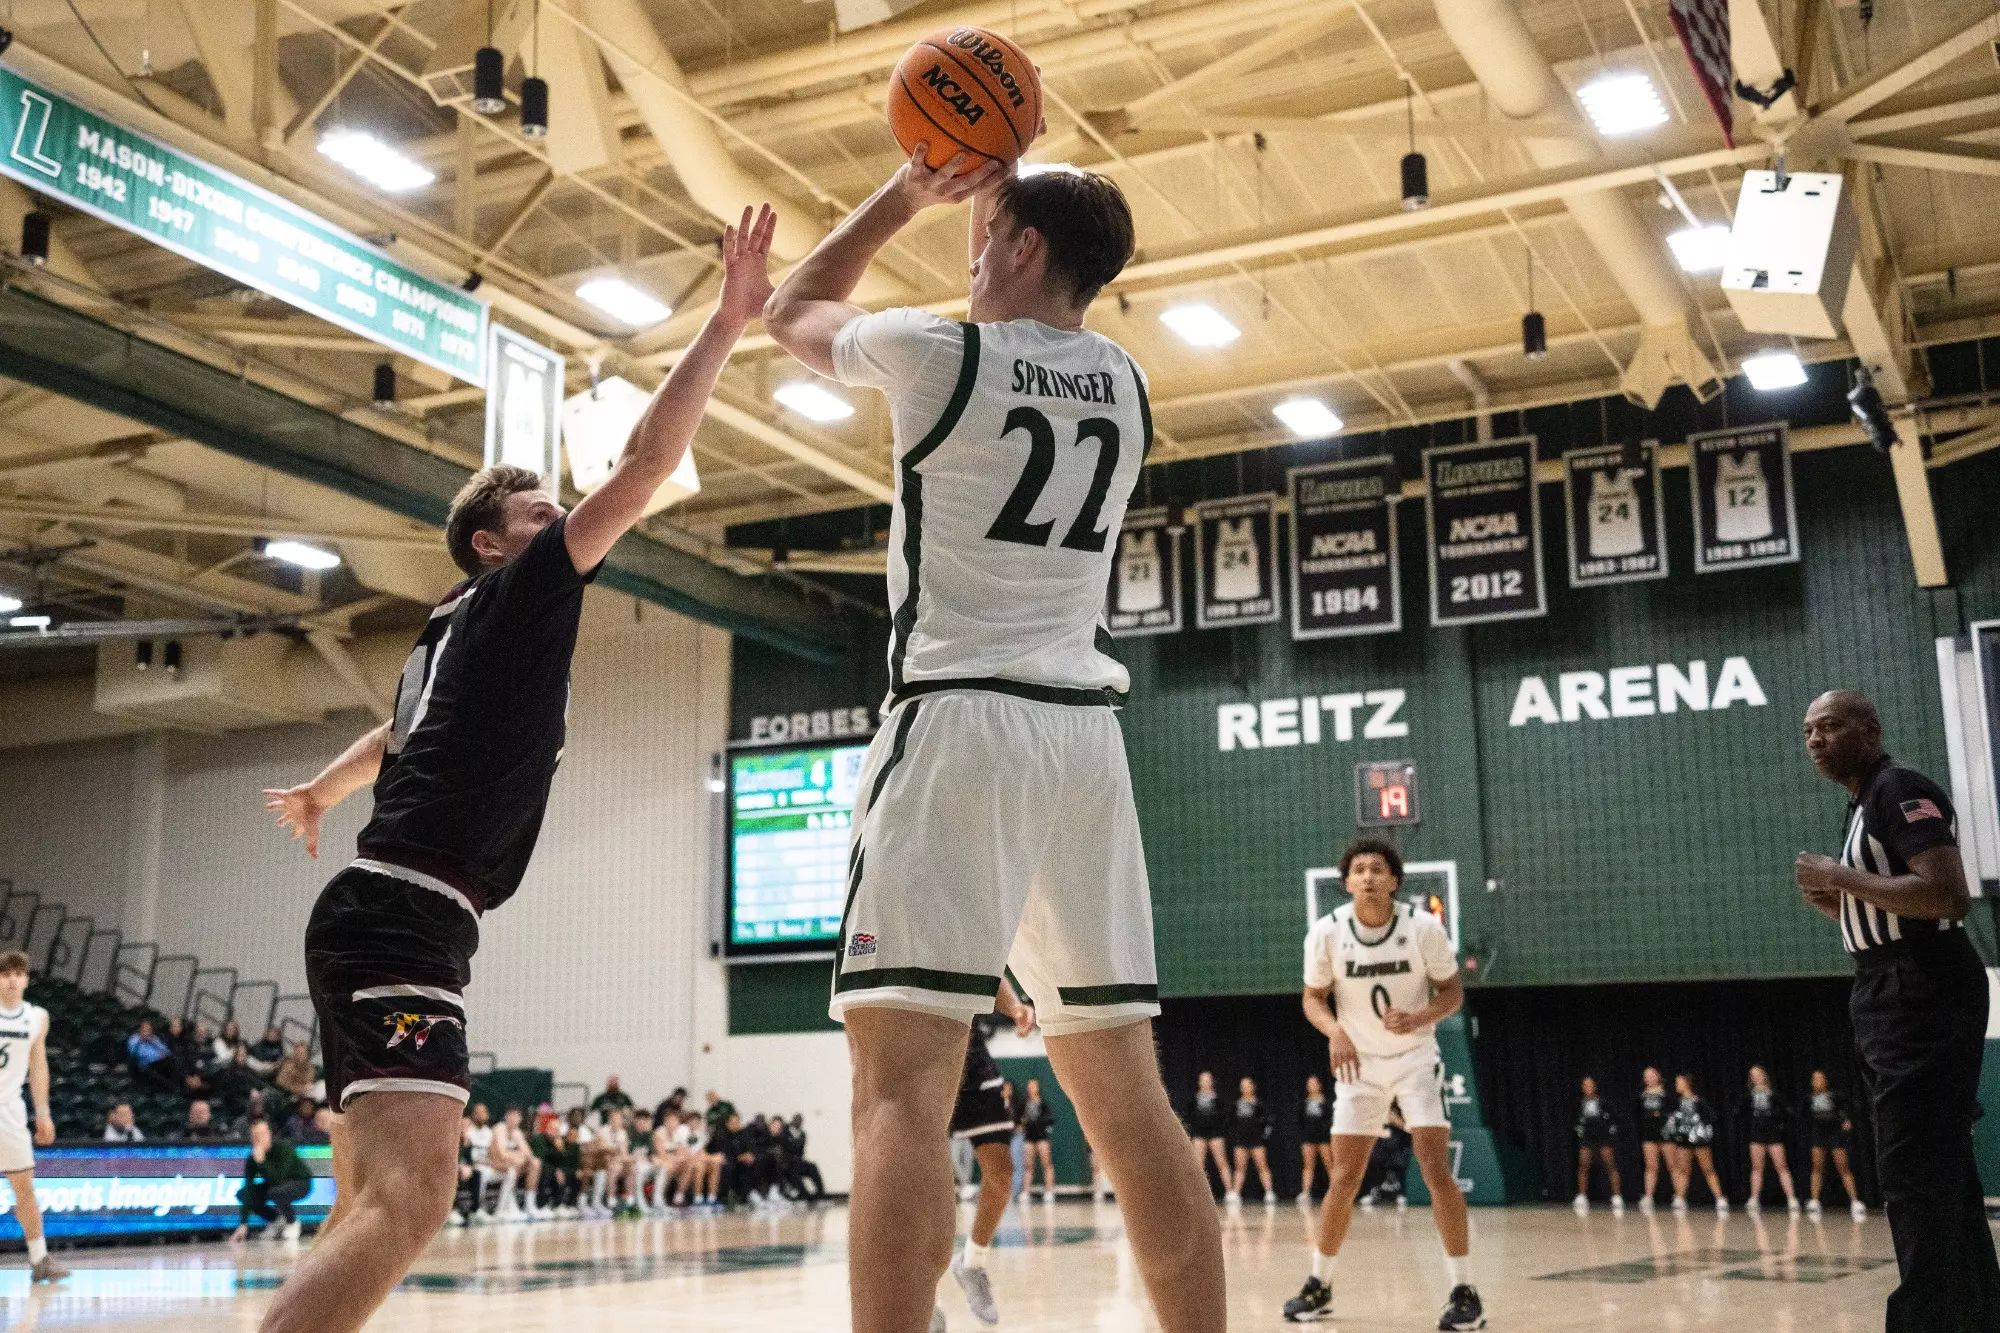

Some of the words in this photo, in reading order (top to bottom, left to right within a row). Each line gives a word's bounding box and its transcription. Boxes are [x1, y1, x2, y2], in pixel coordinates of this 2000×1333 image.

[947, 28, 1025, 110] Wilson
[920, 64, 985, 126] NCAA
[10, 89, 61, 178] L
[77, 162, 126, 202] 1942
[149, 197, 195, 232] 1947
[78, 125, 243, 223] MASON-DIXON
[245, 206, 374, 286] CONFERENCE
[375, 269, 478, 333] CHAMPIONS
[1012, 358, 1117, 405] SPRINGER
[984, 406, 1121, 553] 22
[1727, 486, 1757, 509] 12
[1449, 512, 1519, 542] NCAA
[1599, 503, 1630, 523] 24
[1311, 529, 1377, 558] NCAA
[1311, 584, 1379, 617] 1994
[1450, 569, 1523, 603] 2012
[751, 706, 869, 739] FORBES
[1217, 689, 1409, 751] REITZ
[1509, 656, 1768, 726] ARENA
[106, 1175, 213, 1217] Imaging
